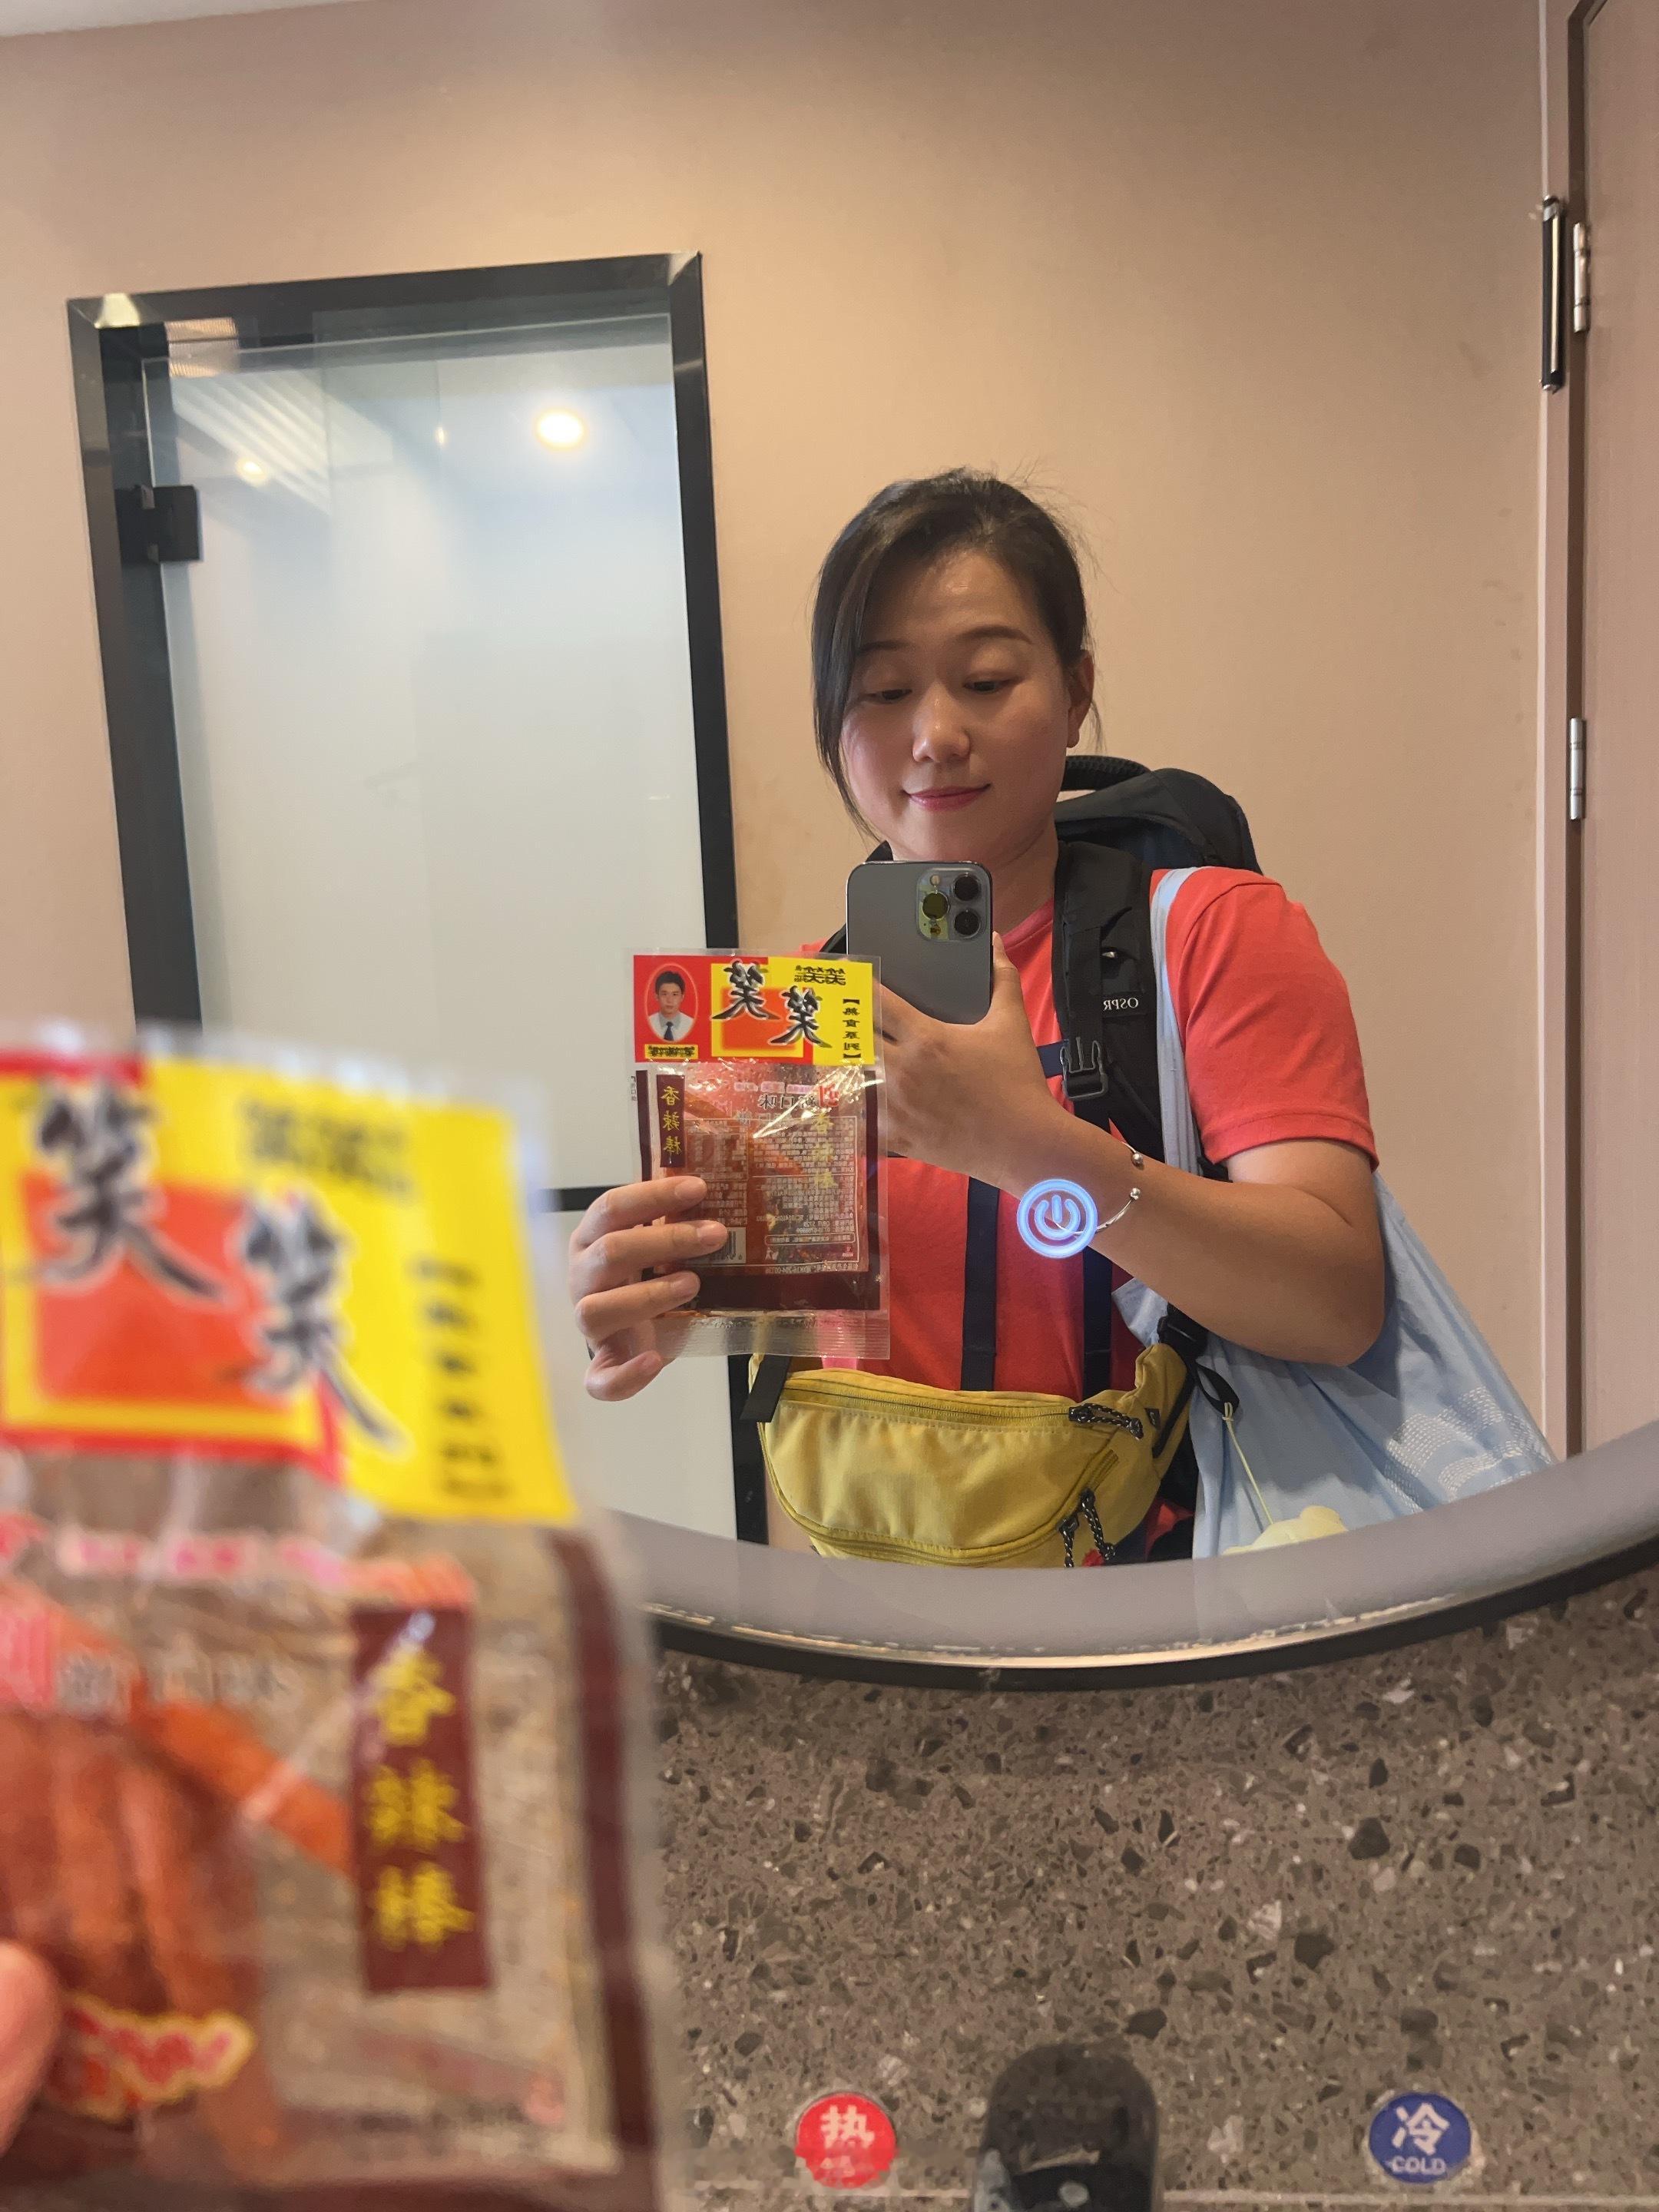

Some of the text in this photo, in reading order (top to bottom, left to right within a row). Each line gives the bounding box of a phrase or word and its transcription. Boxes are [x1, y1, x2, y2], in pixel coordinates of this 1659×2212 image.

[820, 2104, 876, 2150] 热
[1392, 2103, 1450, 2156] 冷
[1391, 2156, 1446, 2176] COLD
